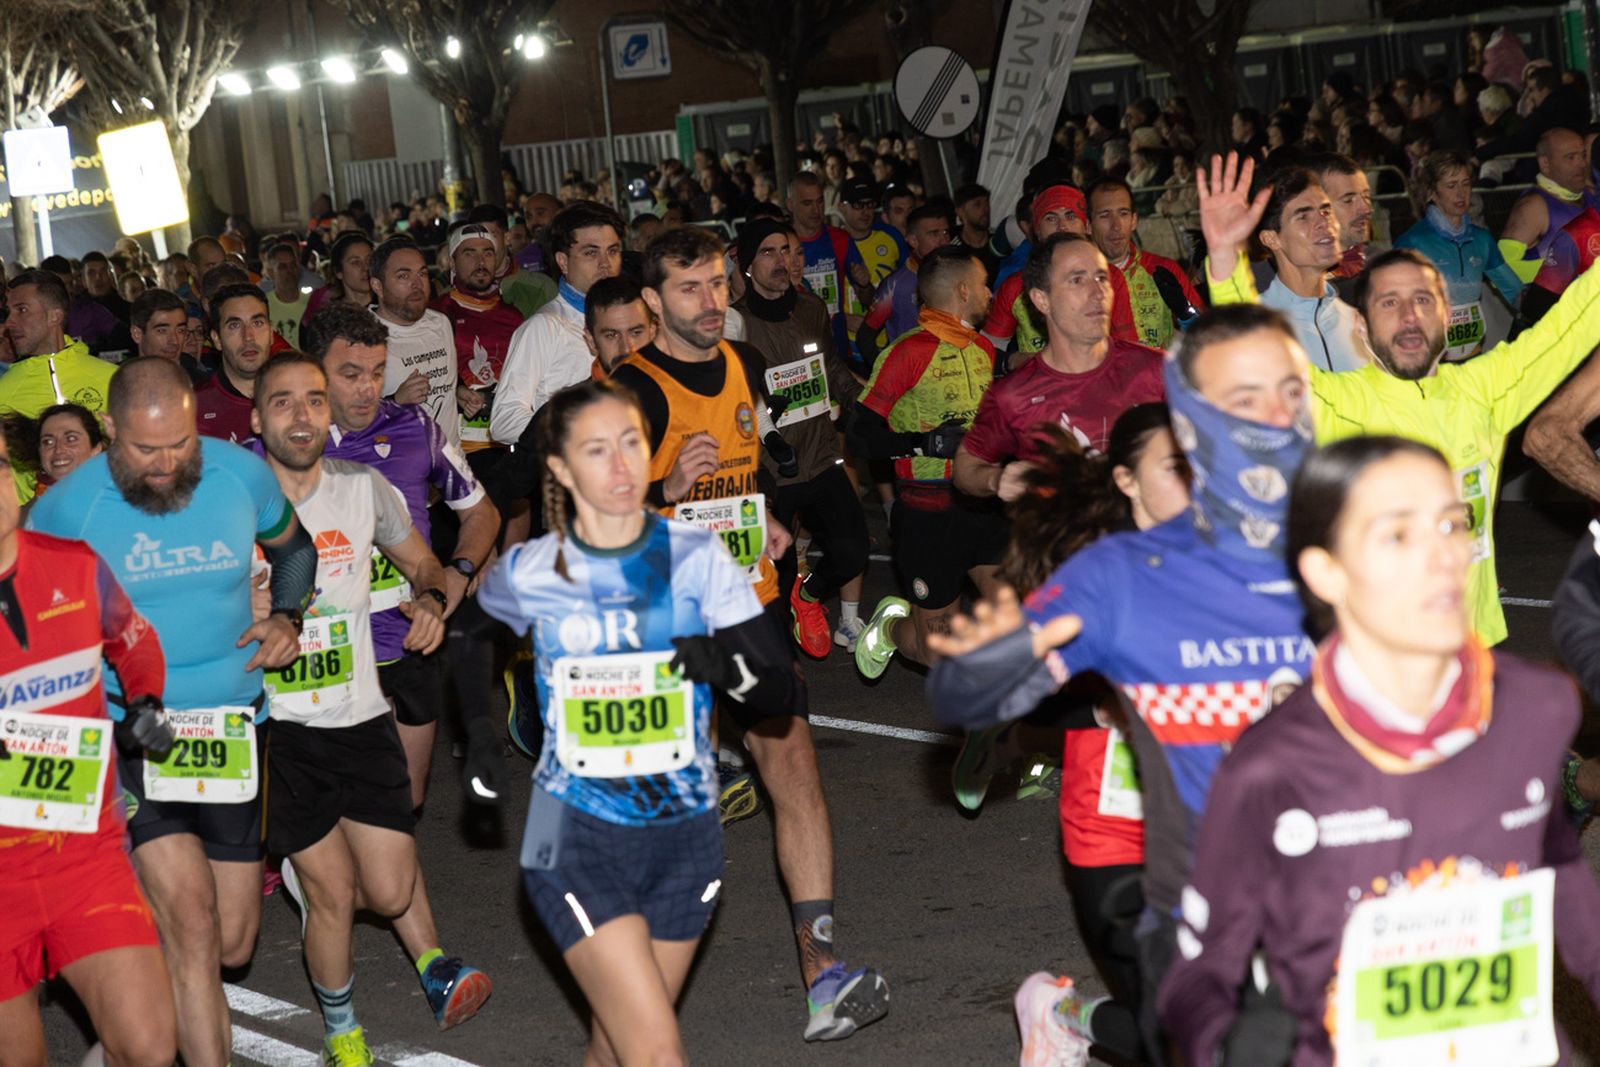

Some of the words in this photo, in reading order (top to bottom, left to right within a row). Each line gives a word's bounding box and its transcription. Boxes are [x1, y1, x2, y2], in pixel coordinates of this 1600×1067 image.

[414, 347, 447, 365] campeones
[425, 365, 449, 380] osotros
[781, 369, 799, 380] NOCHE
[696, 509, 723, 521] NOCHE
[725, 508, 734, 518] DE
[719, 530, 751, 558] 81
[125, 540, 235, 572] ULTRA
[309, 629, 321, 639] DE
[300, 640, 322, 651] TÓN
[585, 671, 623, 681] NOCHE
[571, 685, 597, 697] SAN
[169, 714, 200, 725] NOCHE
[202, 715, 215, 726] DE
[582, 696, 669, 735] 5030
[20, 727, 53, 739] NOCHE
[56, 729, 69, 741] DE
[3, 739, 27, 751] SAN
[173, 739, 228, 768] 299
[20, 755, 75, 791] 782
[1384, 952, 1513, 1017] 5029
